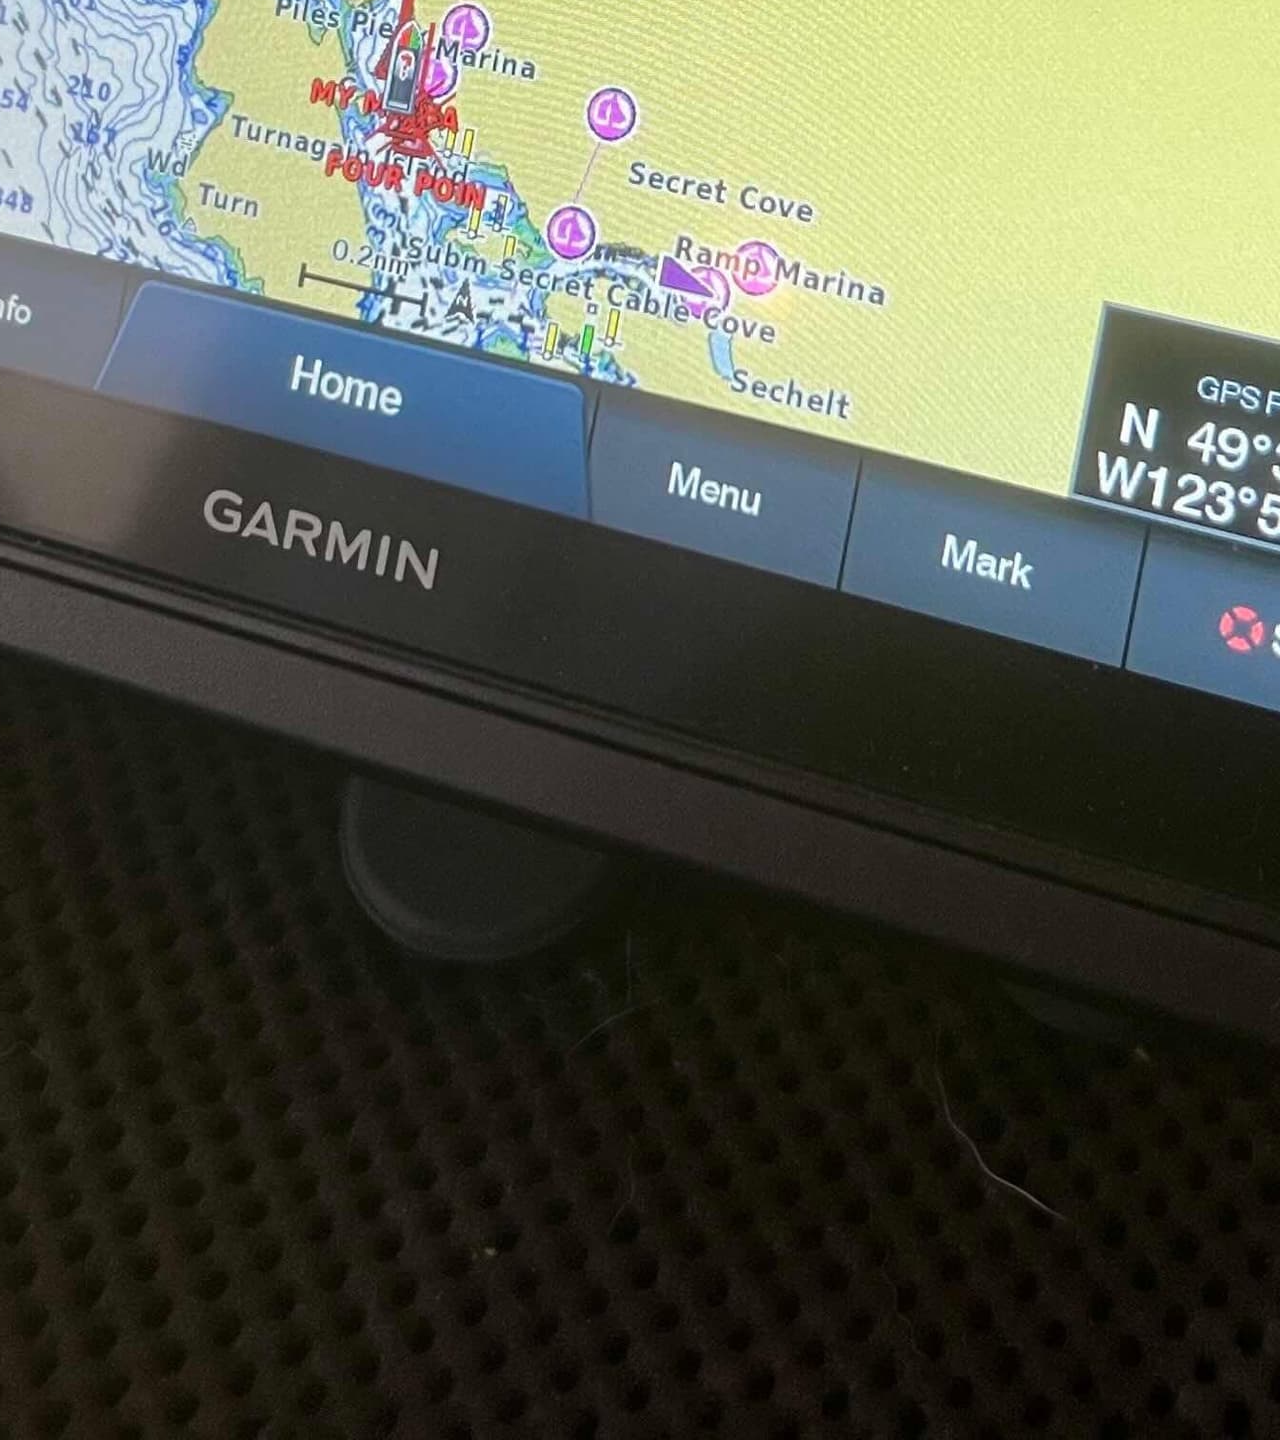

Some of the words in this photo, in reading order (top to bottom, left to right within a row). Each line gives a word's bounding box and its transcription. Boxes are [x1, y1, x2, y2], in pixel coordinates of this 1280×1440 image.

[435, 38, 536, 80] Marina
[310, 77, 355, 110] MY
[148, 148, 188, 178] Wd
[325, 149, 402, 192] FOUR
[199, 183, 259, 217] Turn
[628, 162, 728, 203] Secret
[739, 186, 814, 222] Cove
[409, 238, 486, 275] Subm
[500, 258, 594, 301] Secret
[607, 284, 690, 323] Cable
[703, 305, 776, 343] Cove
[675, 235, 761, 280] Ramp
[775, 259, 885, 306] Marina
[290, 355, 404, 416] Home
[730, 369, 850, 419] Sechelt
[1196, 375, 1262, 413] GPS
[1119, 402, 1160, 451] N
[667, 461, 762, 517] Menu
[202, 489, 440, 591] GARMIN
[941, 533, 1034, 590] Mark
